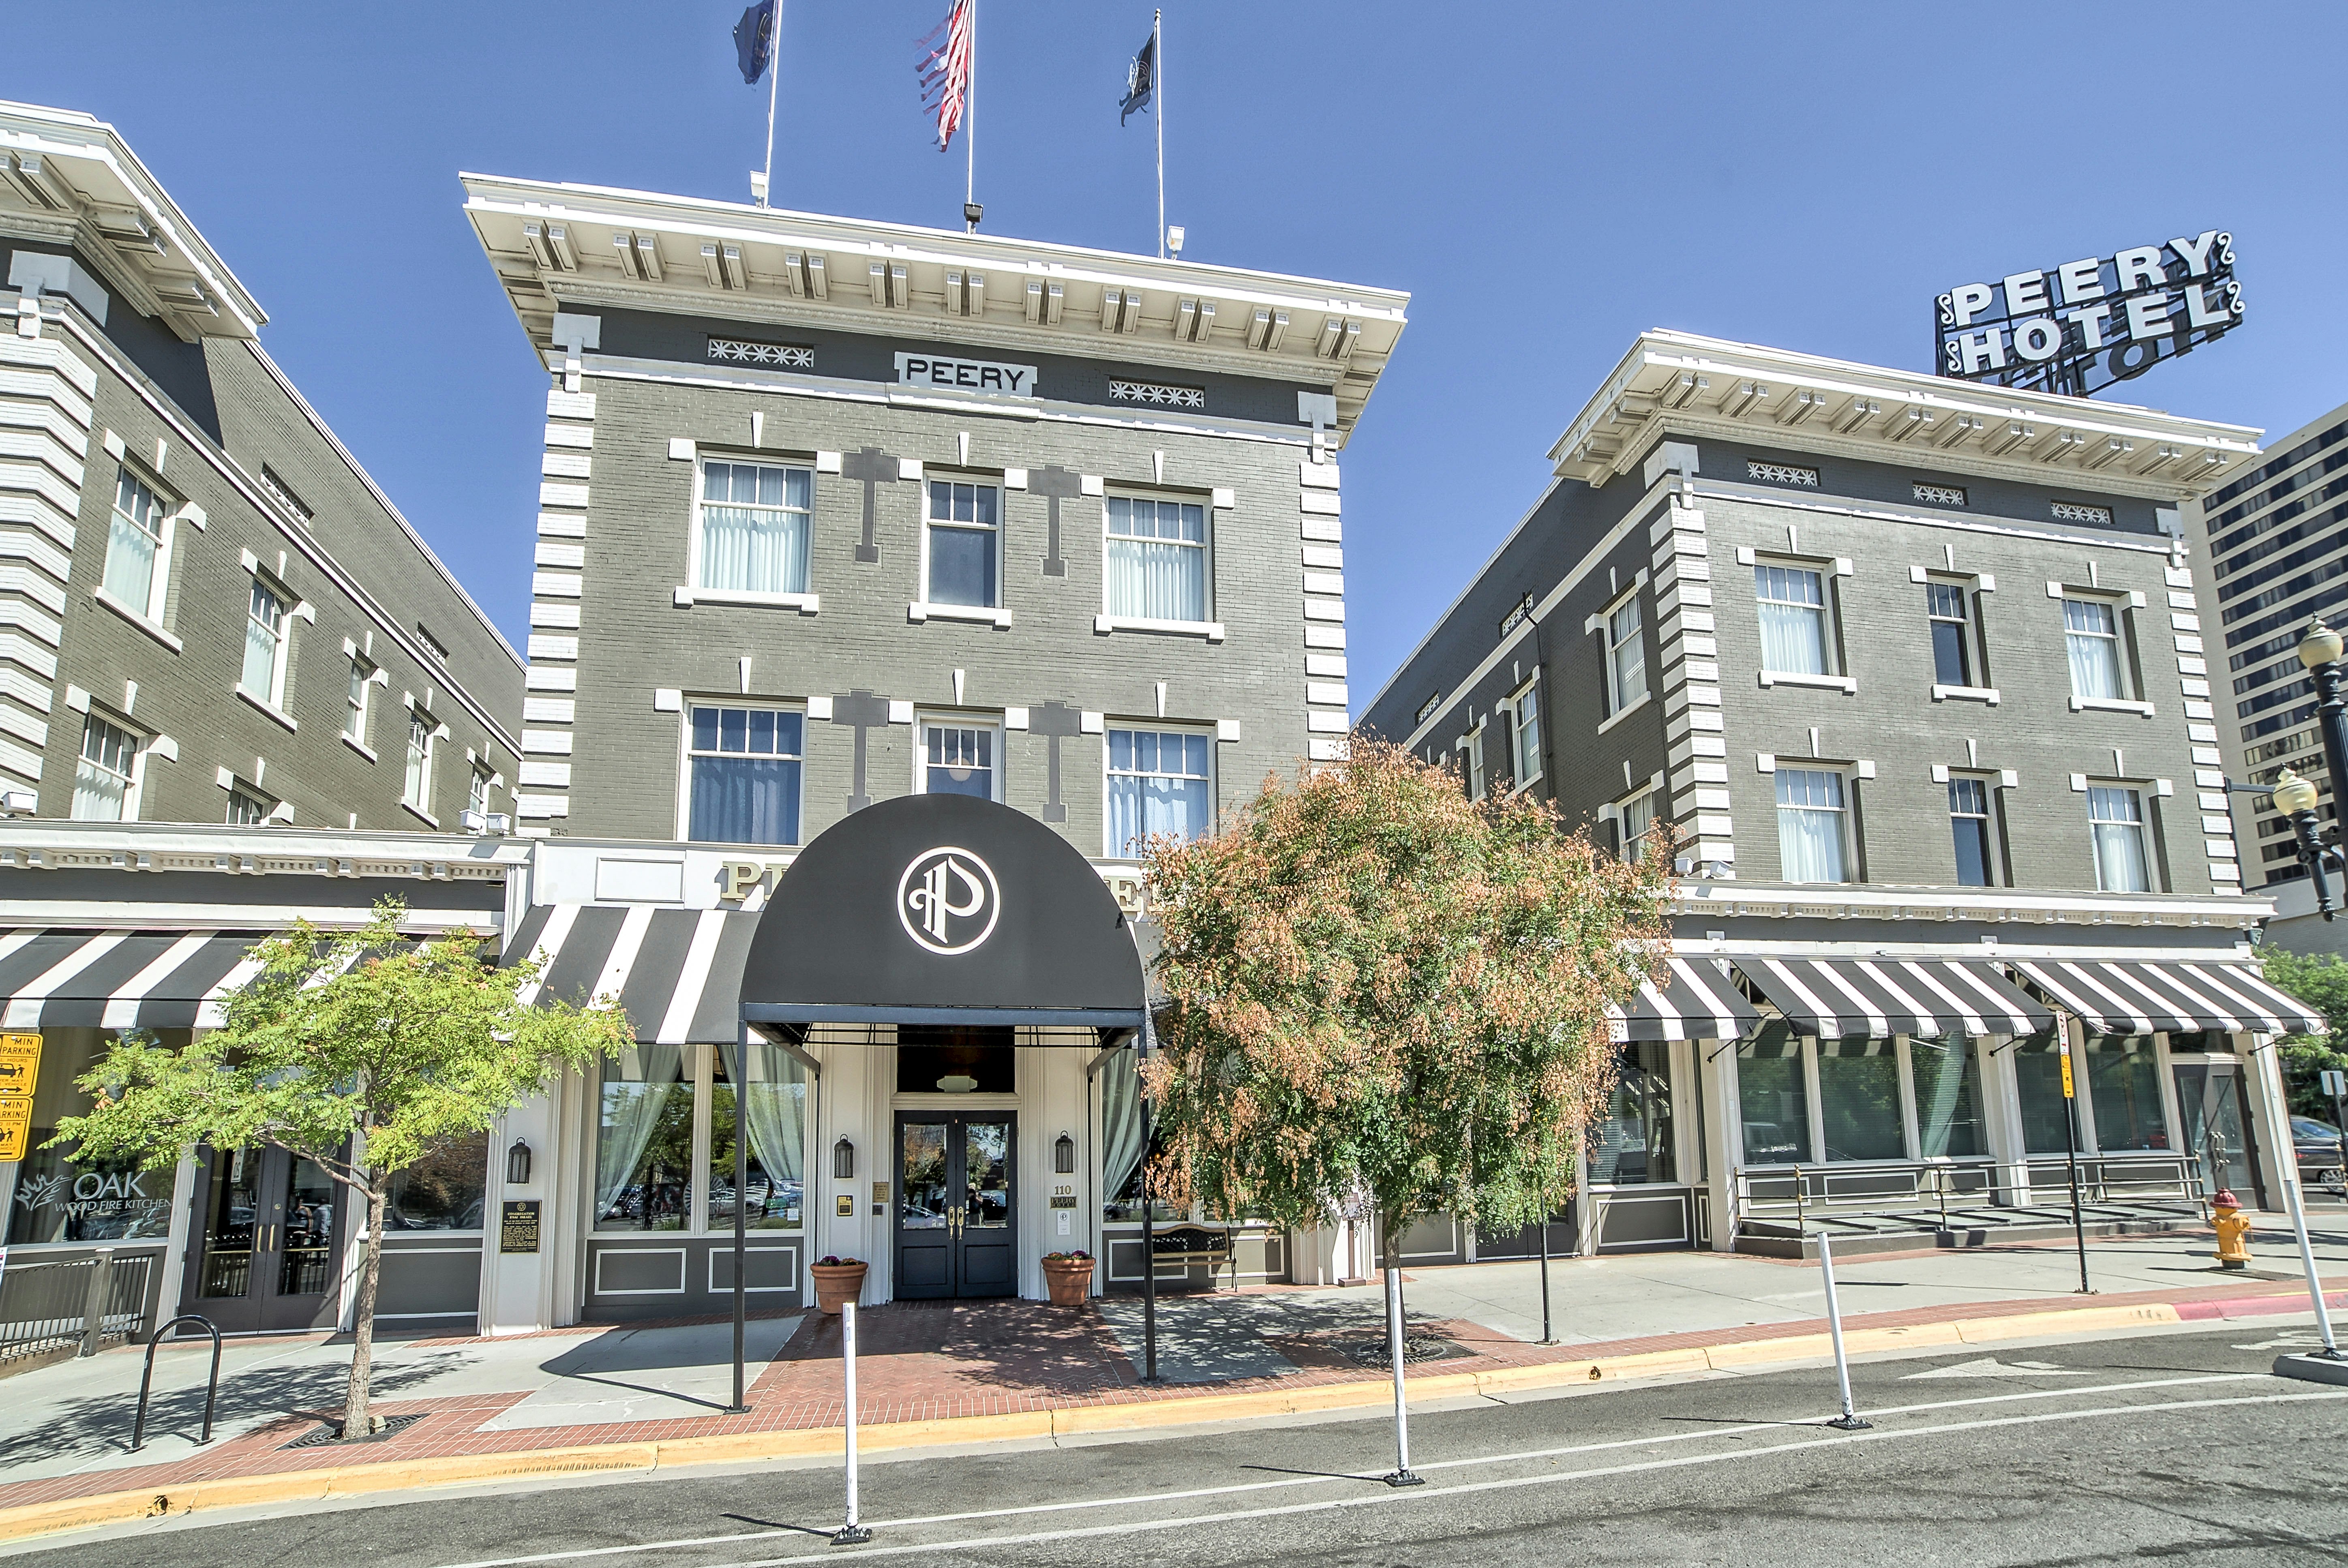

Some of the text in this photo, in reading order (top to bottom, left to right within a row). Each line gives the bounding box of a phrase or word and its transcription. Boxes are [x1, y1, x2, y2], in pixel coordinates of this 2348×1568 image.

[1951, 229, 2219, 327] PEERY
[1958, 283, 2230, 375] HOTEL
[906, 358, 1024, 391] PEERY
[2, 1047, 36, 1055] PARKING
[74, 1172, 146, 1200] OAK
[1055, 1185, 1071, 1195] 110
[55, 1198, 172, 1212] WOOD FIRE KITCHEN
